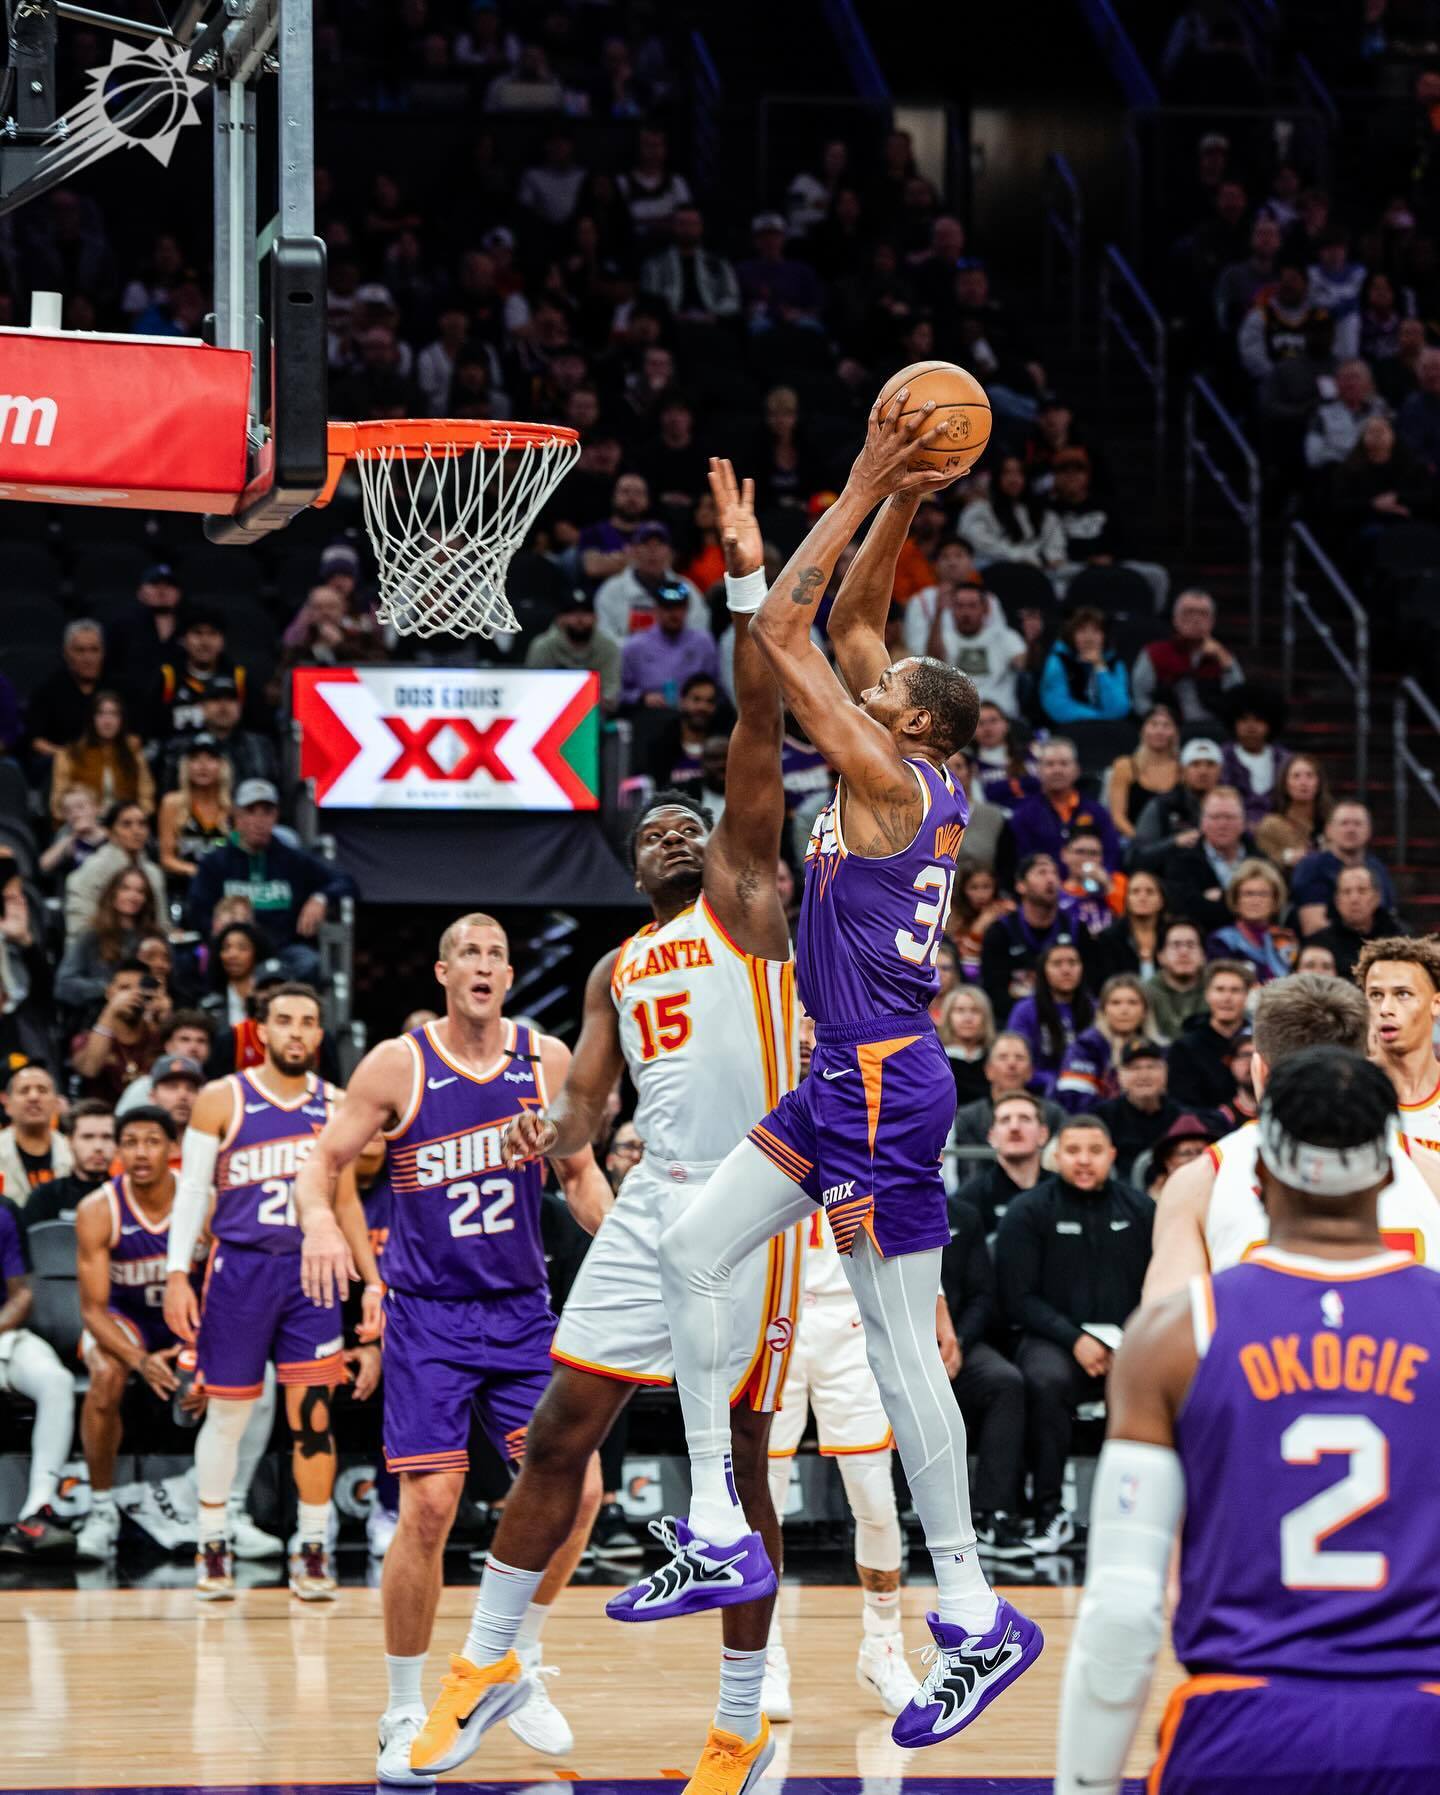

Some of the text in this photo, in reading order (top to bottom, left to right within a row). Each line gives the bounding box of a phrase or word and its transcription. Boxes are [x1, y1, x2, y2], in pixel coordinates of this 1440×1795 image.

[395, 686, 433, 708] DOS
[381, 716, 516, 782] XX
[632, 989, 693, 1061] 15
[503, 1071, 534, 1084] PayPal
[446, 1178, 516, 1239] 22
[822, 1180, 856, 1206] ENIX
[110, 1257, 167, 1287] SUN
[1239, 1332, 1430, 1404] OKOGIE
[616, 1461, 664, 1516] G
[1280, 1414, 1389, 1591] 2
